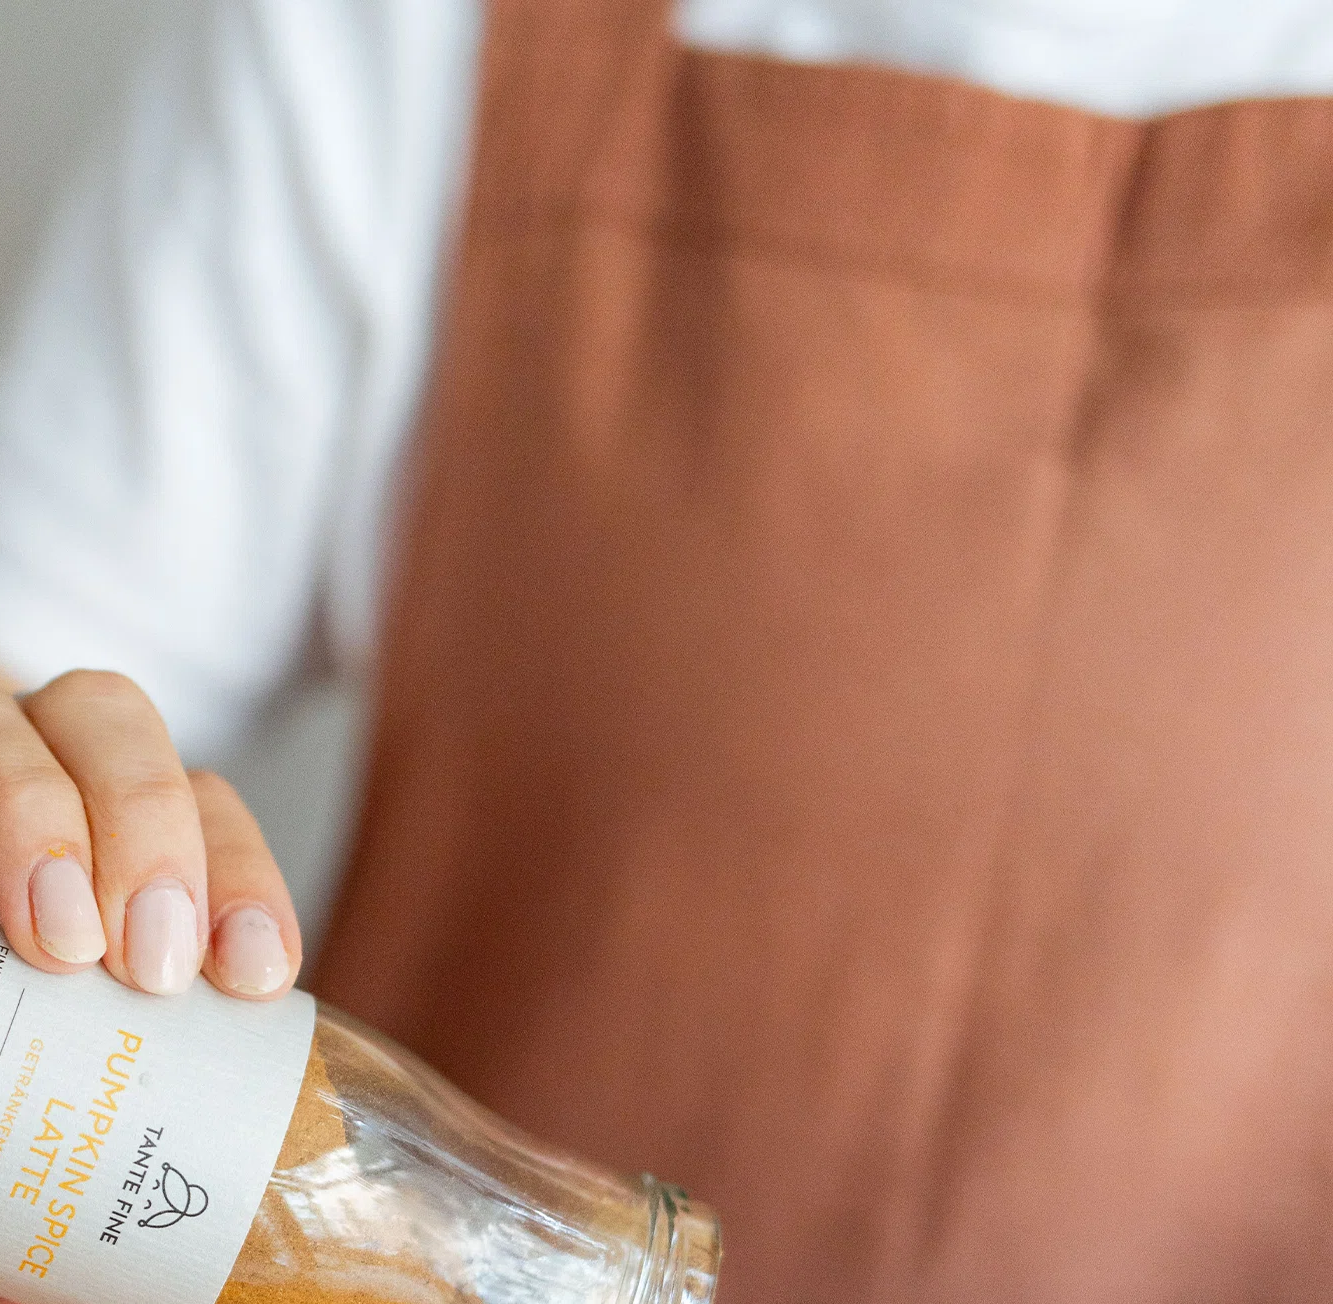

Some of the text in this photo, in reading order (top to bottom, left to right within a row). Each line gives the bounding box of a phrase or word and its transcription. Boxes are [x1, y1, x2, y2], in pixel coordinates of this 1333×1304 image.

[9, 1098, 74, 1206] LATTE
[18, 1029, 143, 1279] PUMPKIN SPICE
[99, 1127, 164, 1246] TANTE FINE
